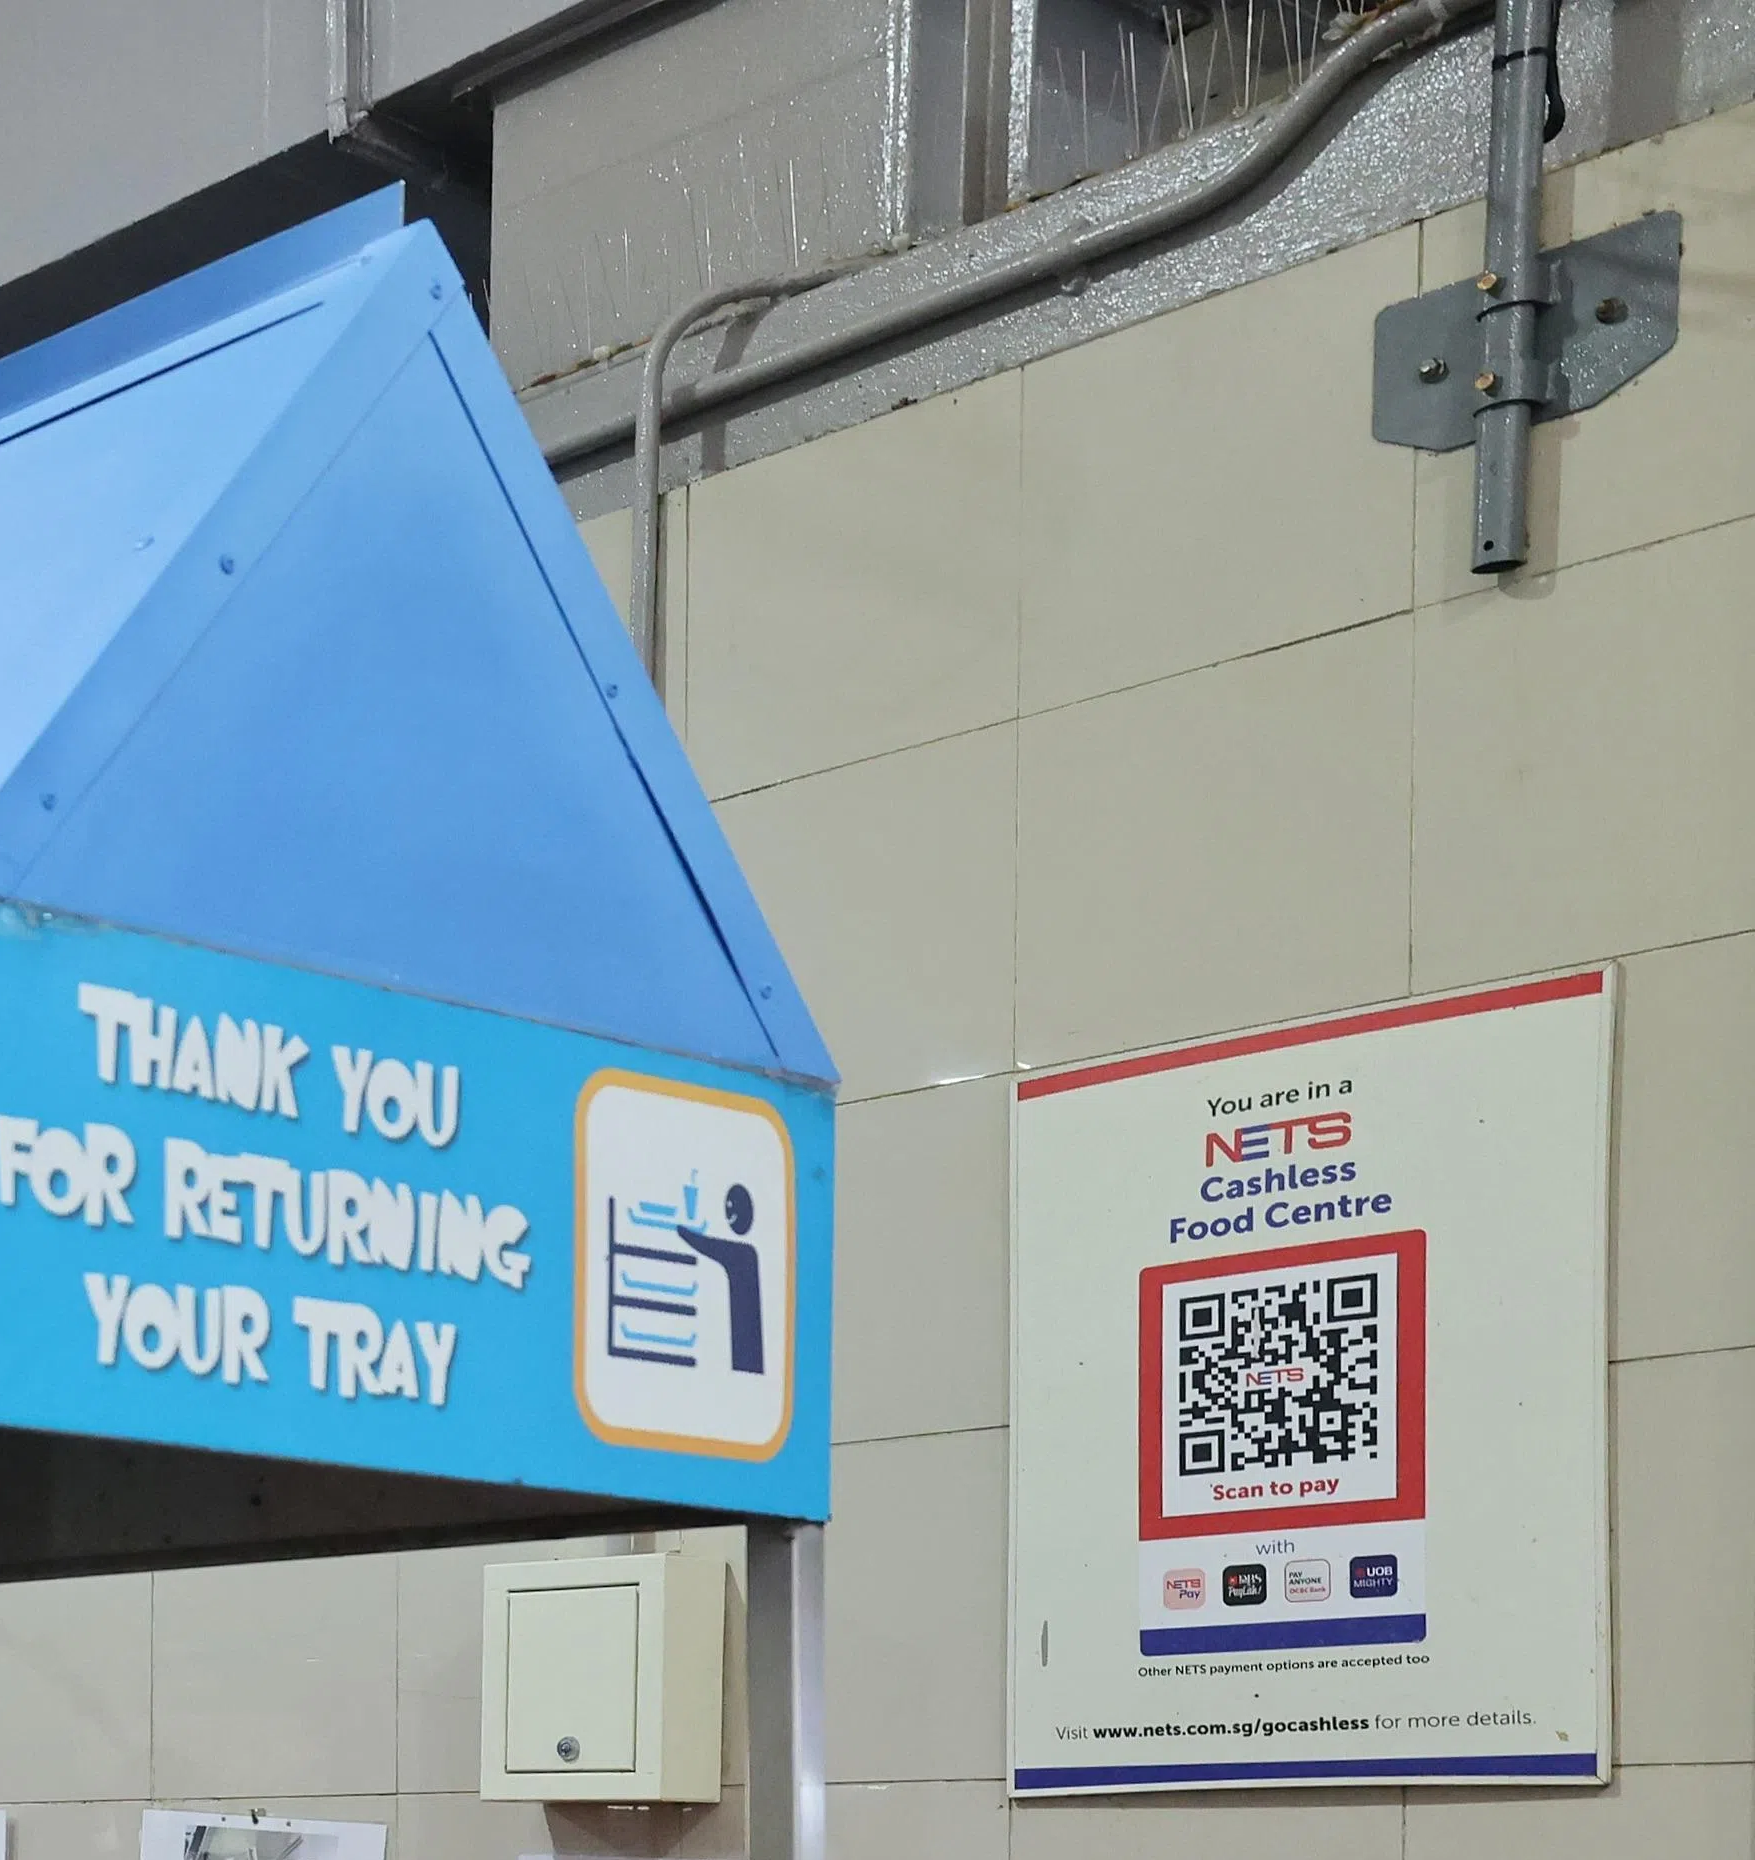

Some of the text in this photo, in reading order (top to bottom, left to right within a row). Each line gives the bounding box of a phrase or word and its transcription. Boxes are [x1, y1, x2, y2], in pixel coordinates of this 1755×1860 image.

[78, 982, 461, 1148] THANK YOU
[1207, 1079, 1353, 1117] You are in a
[1205, 1111, 1353, 1168] NETS
[1200, 1161, 1357, 1202] Cashless
[163, 1137, 532, 1290] RETURNING
[1169, 1193, 1392, 1244] Food Centre
[83, 1272, 458, 1406] YOUR TRAY
[1246, 1368, 1305, 1387] NETS
[1213, 1478, 1340, 1501] Scan to pay
[1255, 1539, 1296, 1556] with
[1353, 1578, 1393, 1588] MIGHTY
[1366, 1566, 1393, 1577] UOB
[1179, 1589, 1200, 1600] Pay
[1138, 1654, 1430, 1677] Other NETS payment options are accepted too
[1055, 1709, 1537, 1741] Visit www.nets.com.sg/gocashless for more details.
